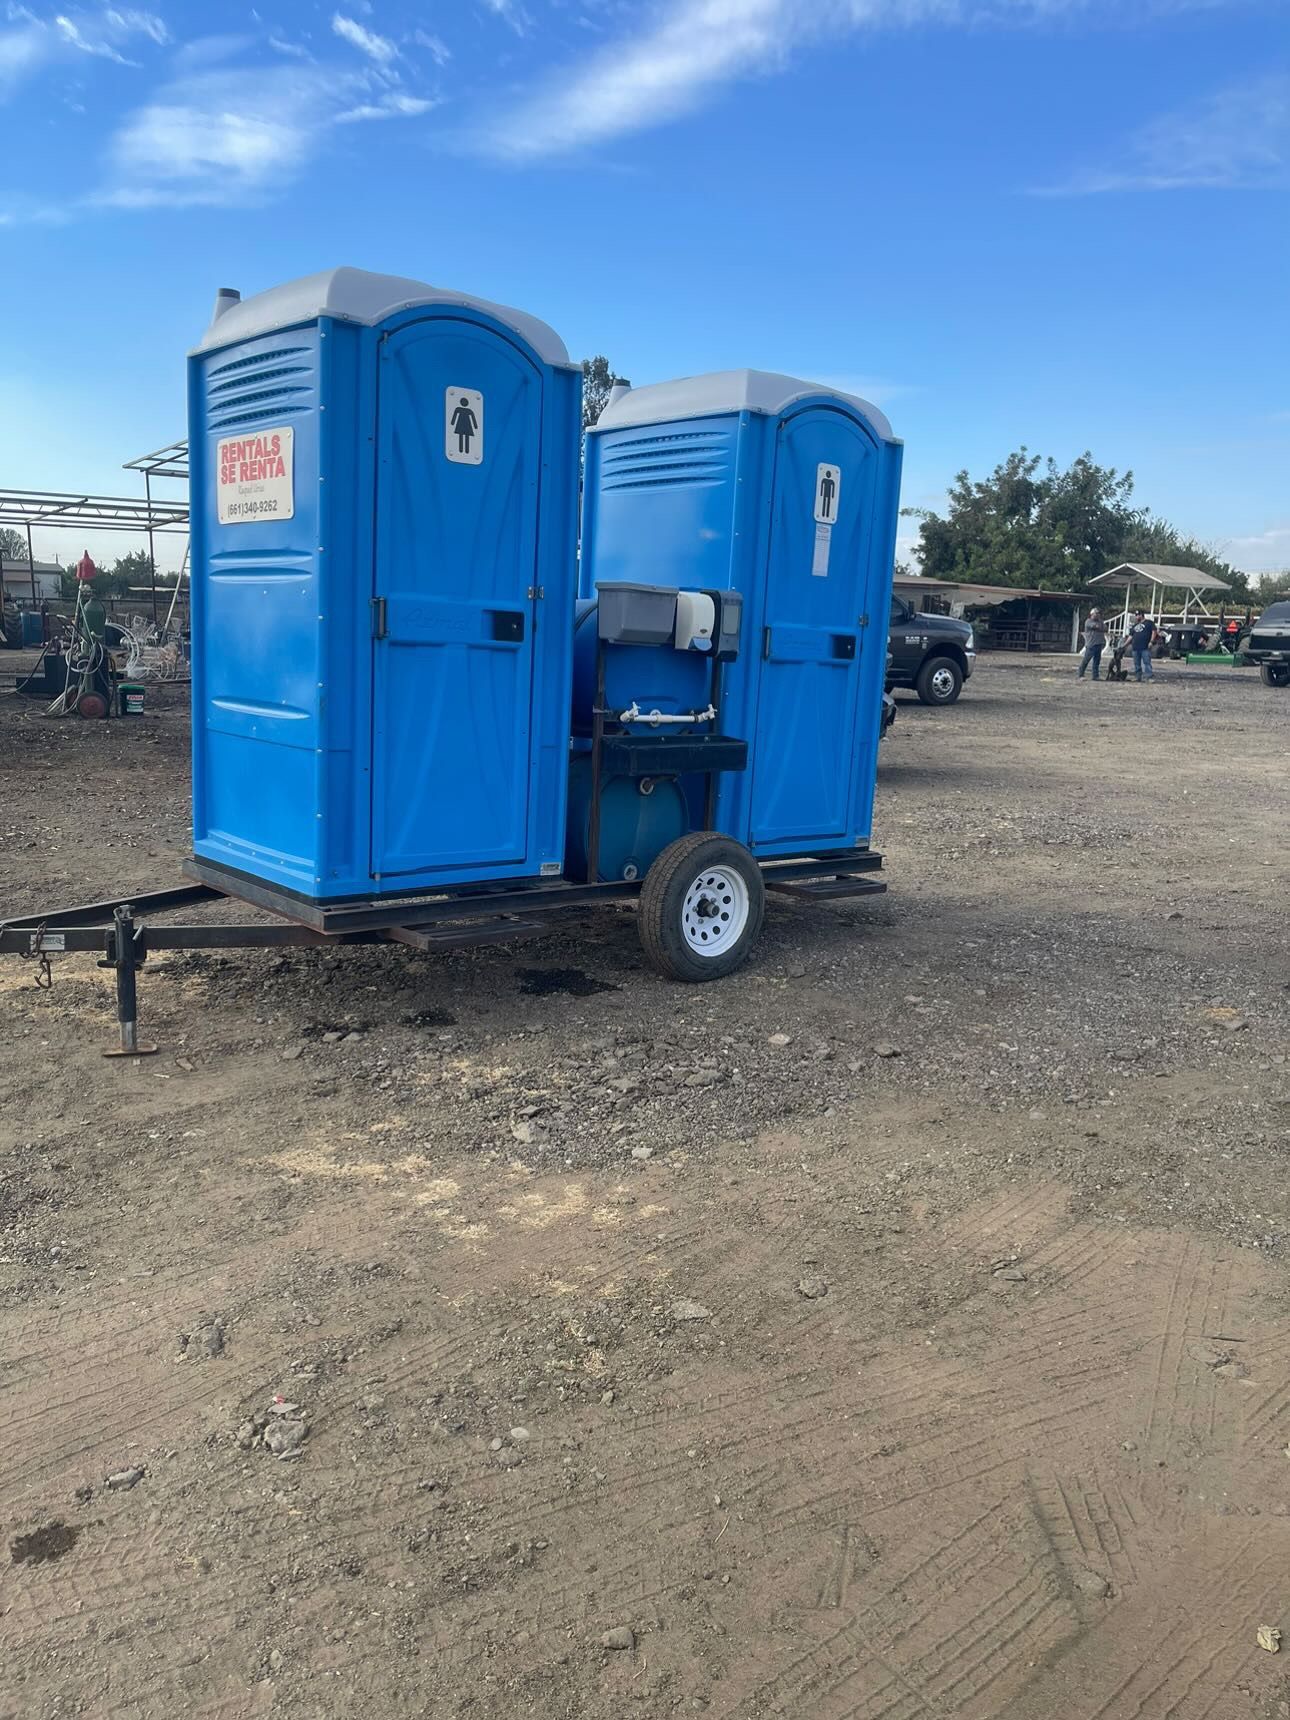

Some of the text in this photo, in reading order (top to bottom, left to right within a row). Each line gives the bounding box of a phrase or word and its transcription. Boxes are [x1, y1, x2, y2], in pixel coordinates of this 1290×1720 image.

[221, 434, 281, 464] RENTALS
[221, 456, 286, 485] SE RENTA
[228, 499, 278, 517] (661)340-9262
